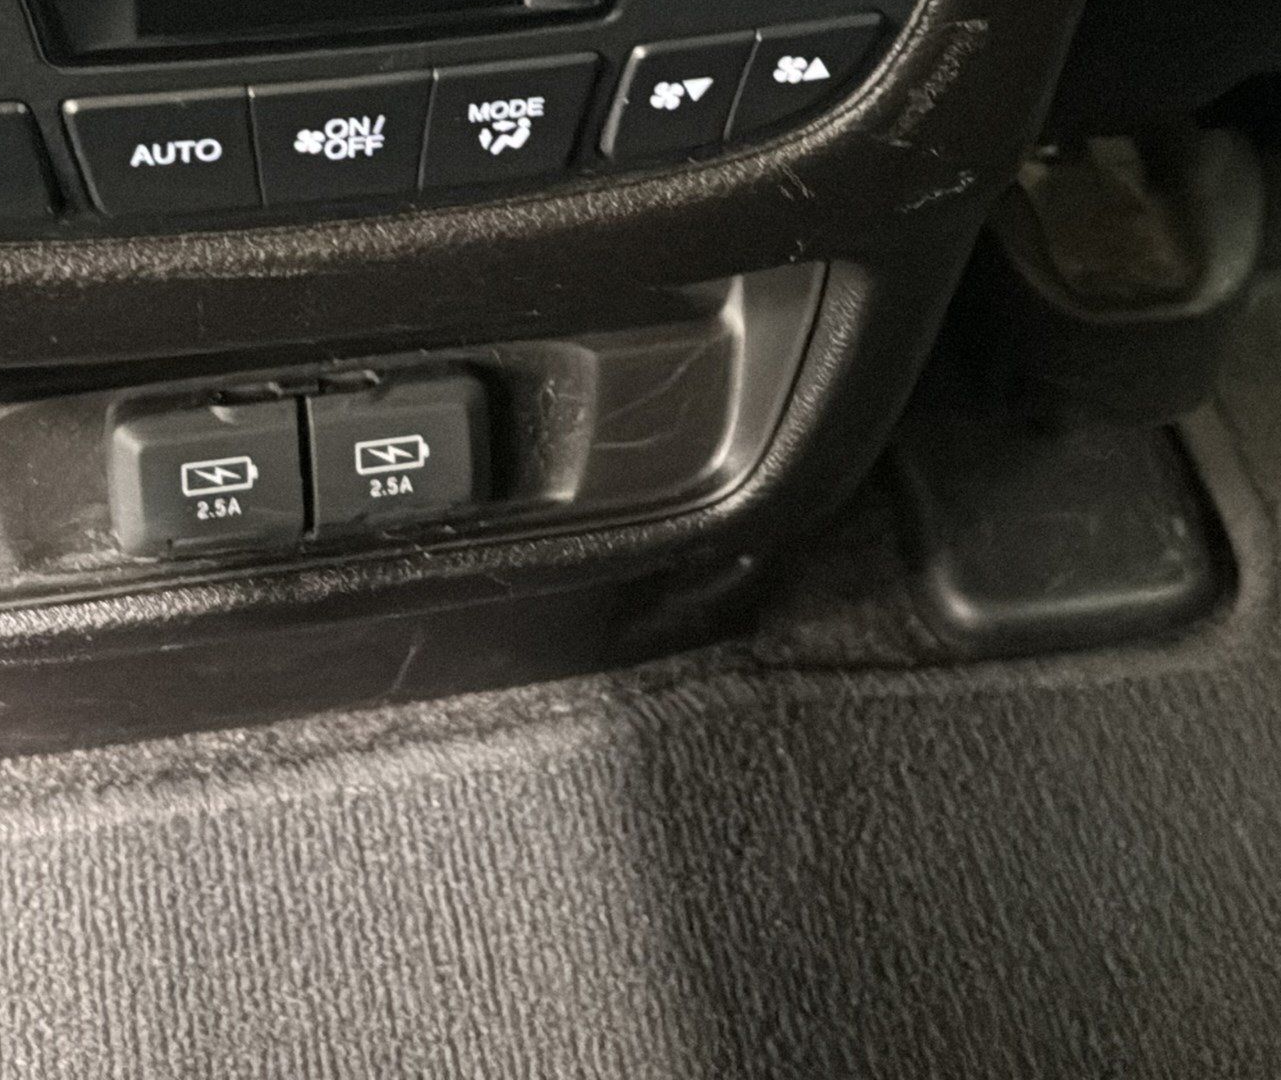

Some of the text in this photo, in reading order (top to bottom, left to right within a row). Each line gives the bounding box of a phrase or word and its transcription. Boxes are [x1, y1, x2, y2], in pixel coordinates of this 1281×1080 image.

[468, 96, 545, 122] MODE
[130, 137, 222, 167] AUTO
[324, 135, 384, 160] OFF
[370, 475, 414, 498] 2.5A
[196, 497, 242, 520] 2.5A
